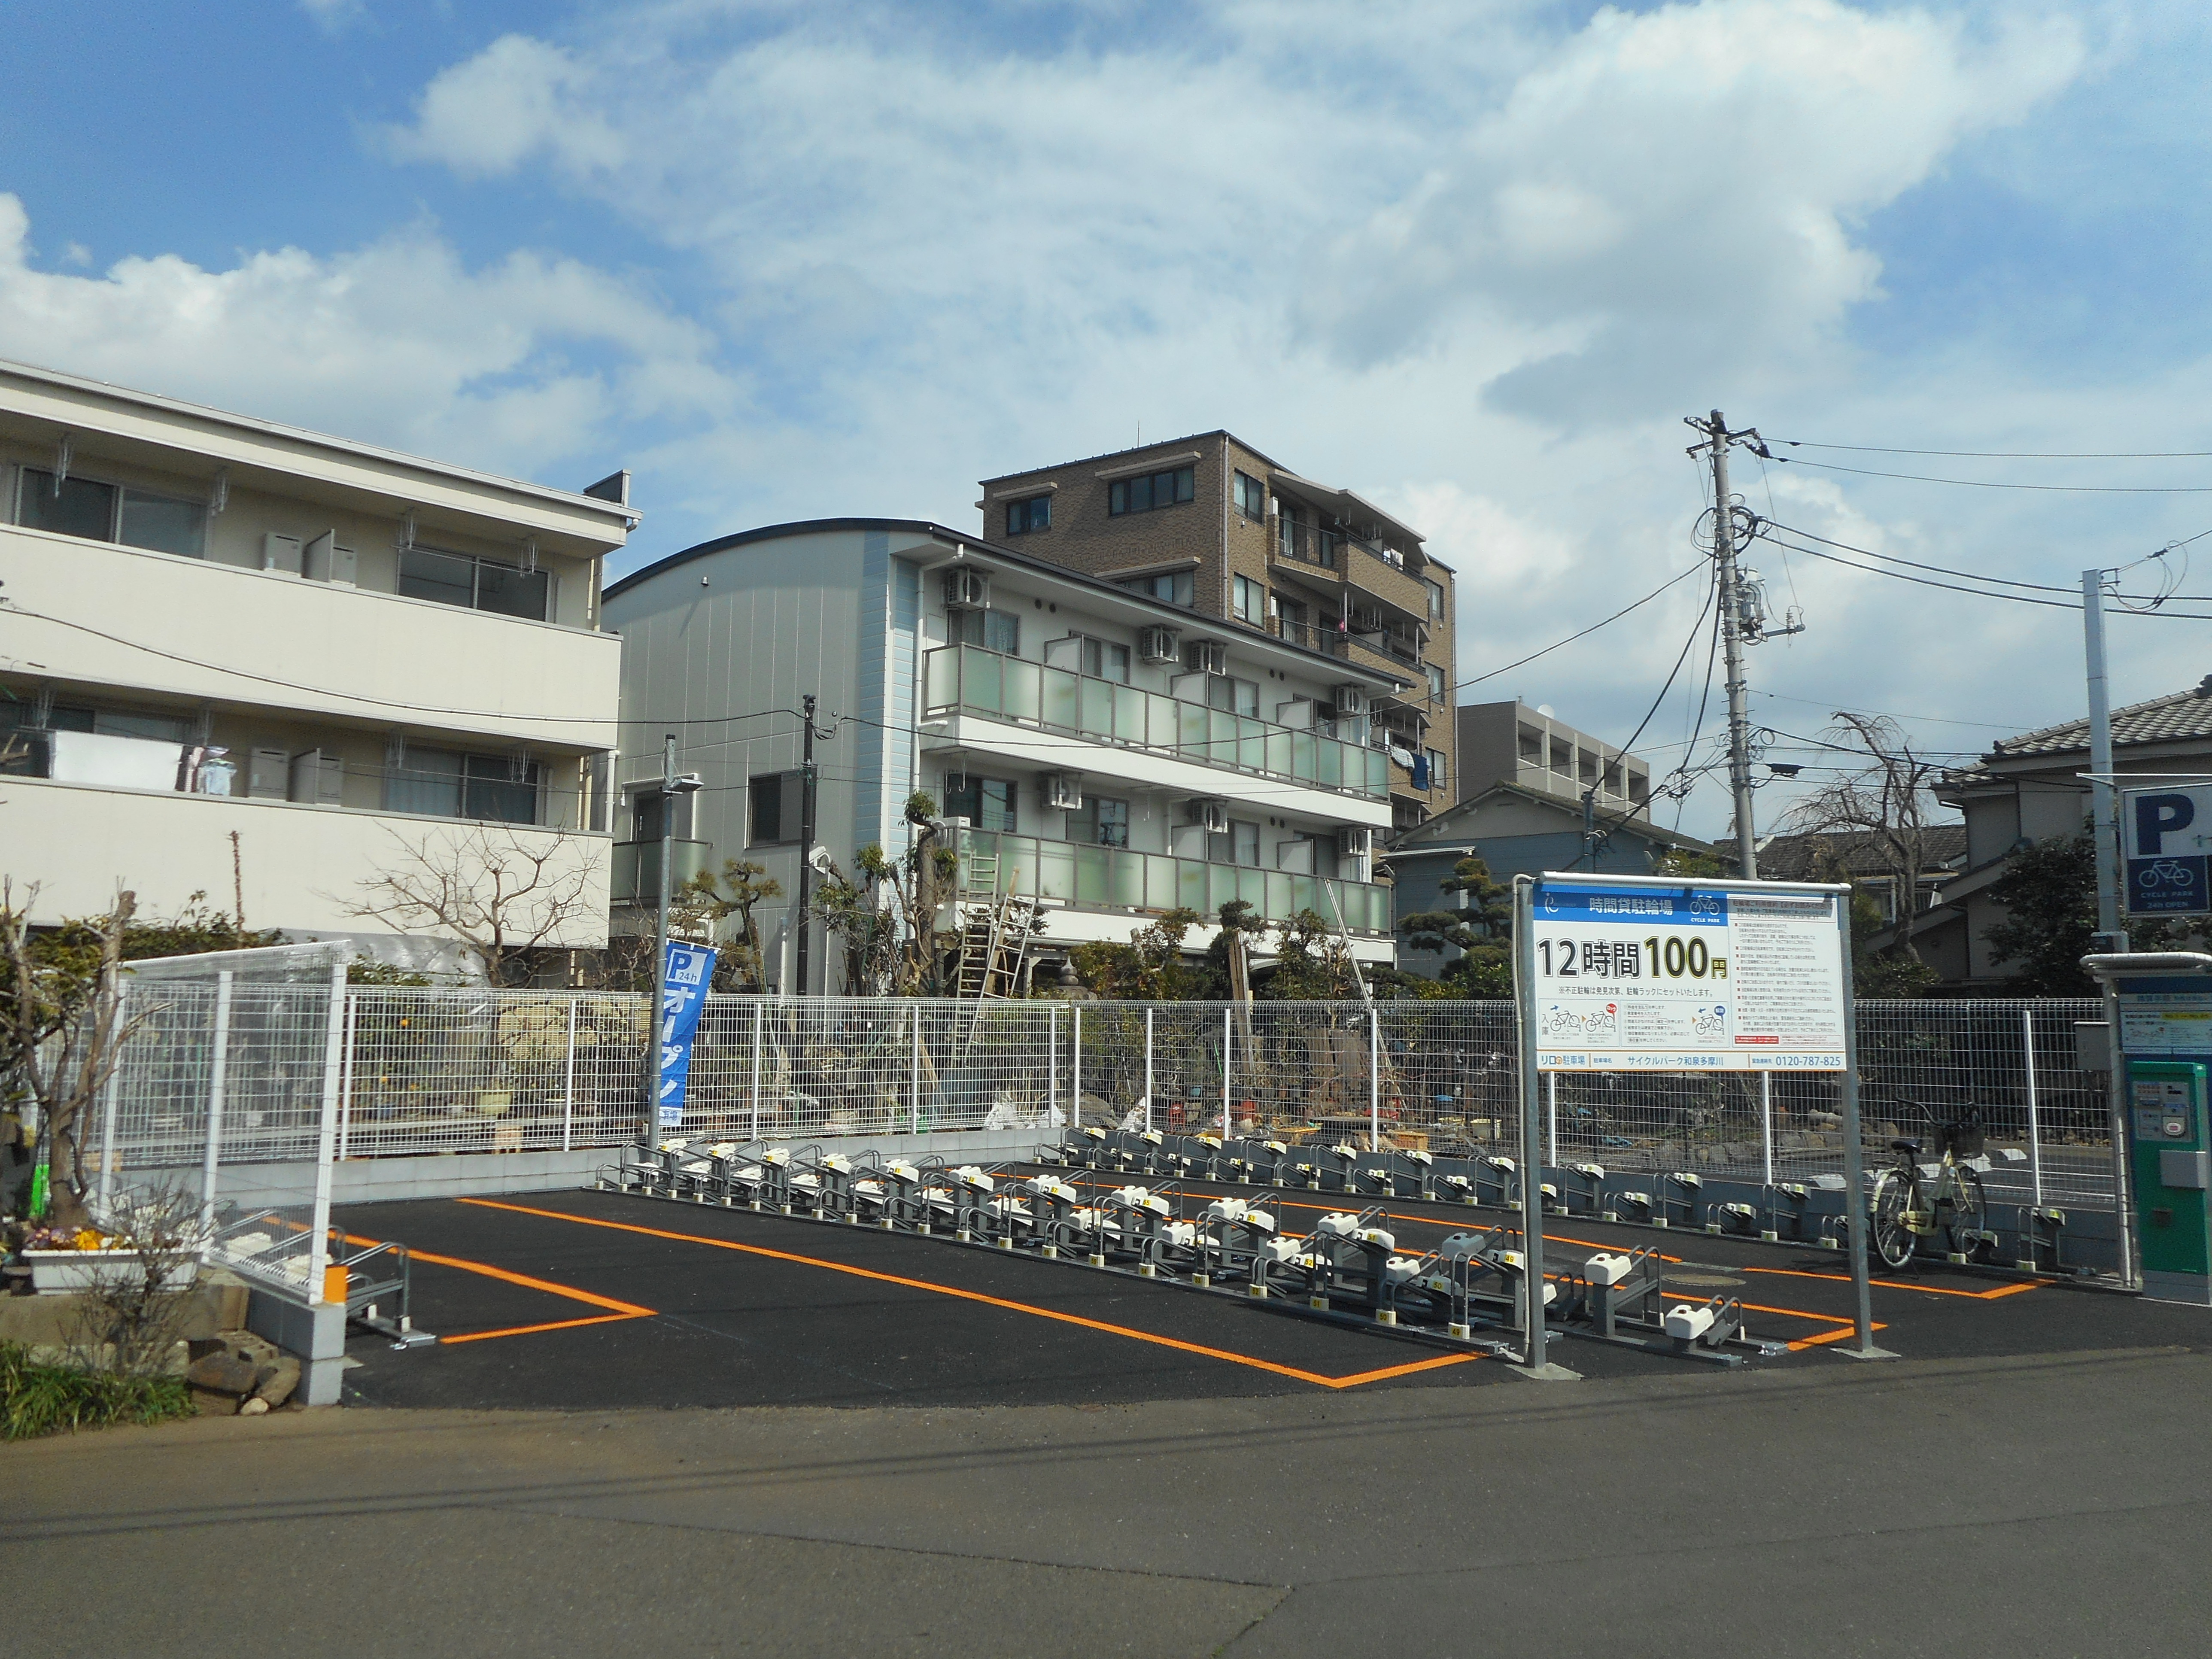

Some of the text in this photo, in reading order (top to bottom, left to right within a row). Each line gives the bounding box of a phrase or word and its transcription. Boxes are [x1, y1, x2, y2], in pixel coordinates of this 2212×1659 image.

[2136, 794, 2194, 855] P
[1589, 897, 1673, 916] 時間貸駐輪場
[1537, 935, 1729, 979] 12時間 100円
[669, 952, 692, 980] P
[678, 972, 697, 982] 24h
[1541, 1055, 1585, 1065] リロの駐車場
[1628, 1056, 1723, 1066] サイクルパーク和泉多摩川
[1776, 1056, 1841, 1066] 0120-787-825
[662, 1109, 678, 1121] 車場
[1380, 1313, 1387, 1321] 50
